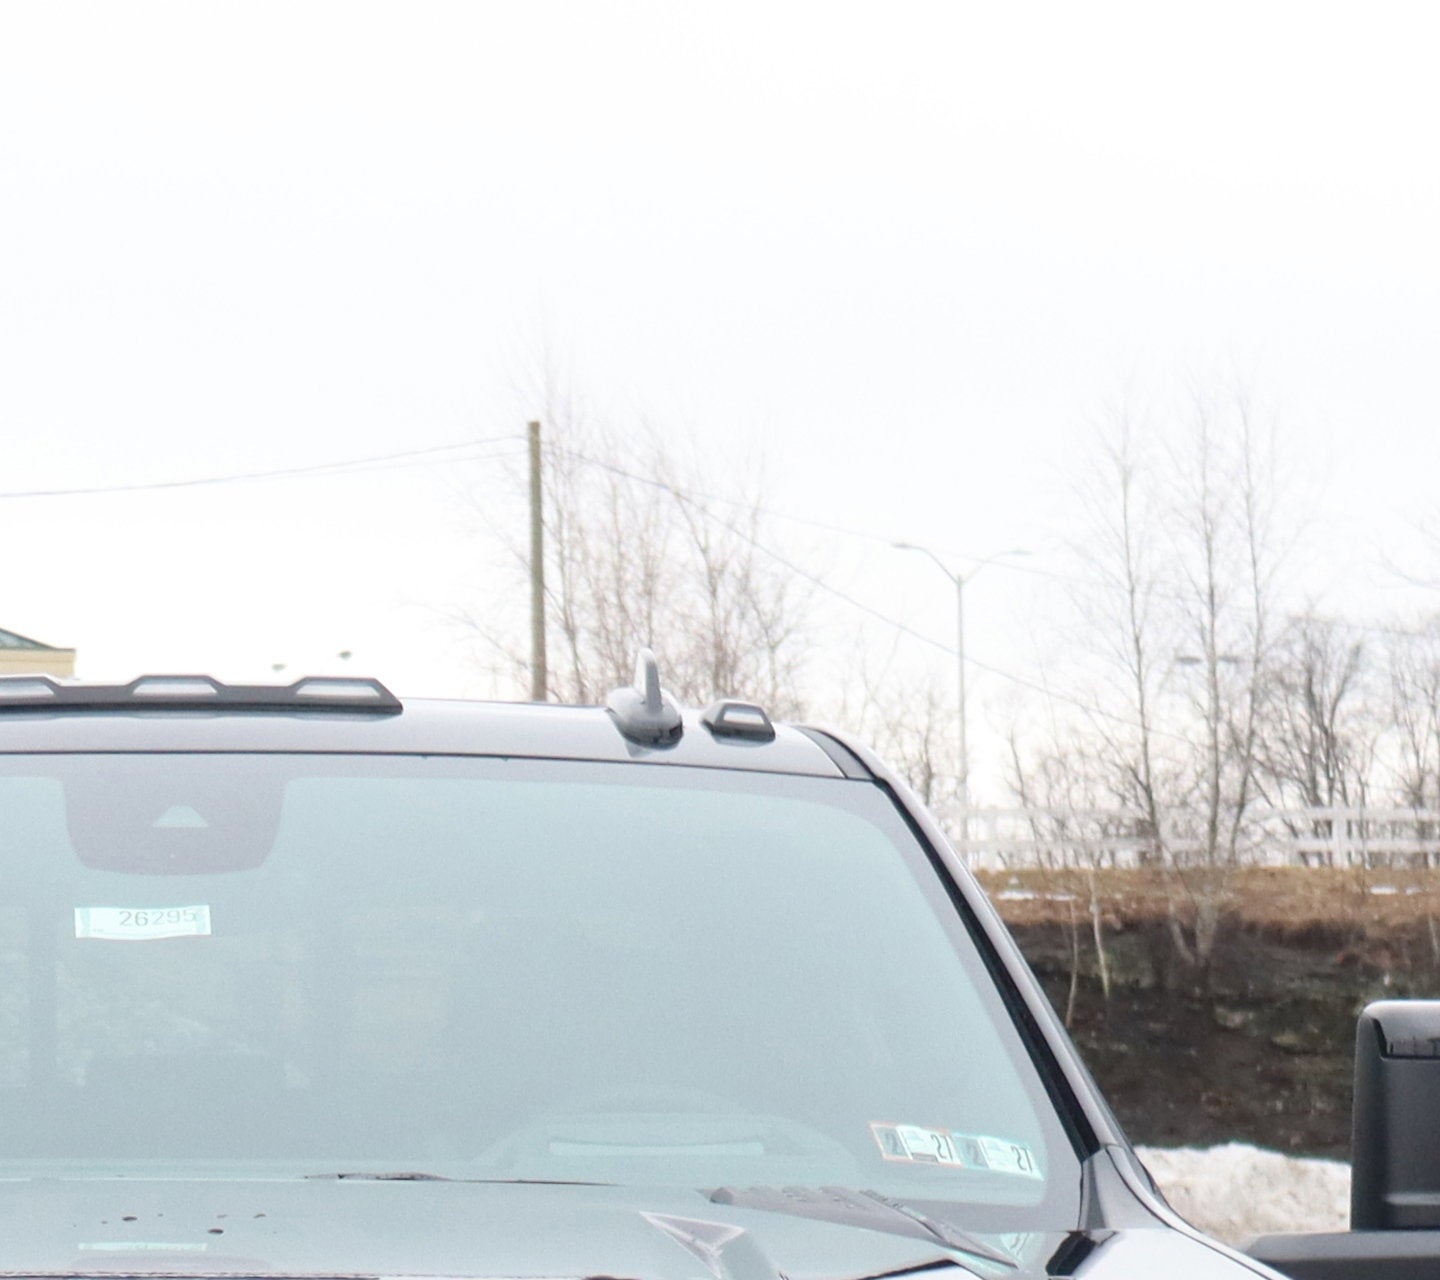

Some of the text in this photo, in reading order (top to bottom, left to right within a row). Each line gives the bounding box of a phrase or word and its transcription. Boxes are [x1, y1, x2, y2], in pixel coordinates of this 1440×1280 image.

[119, 909, 197, 927] 26295
[930, 1134, 954, 1162] 27
[1011, 1145, 1033, 1172] 27
